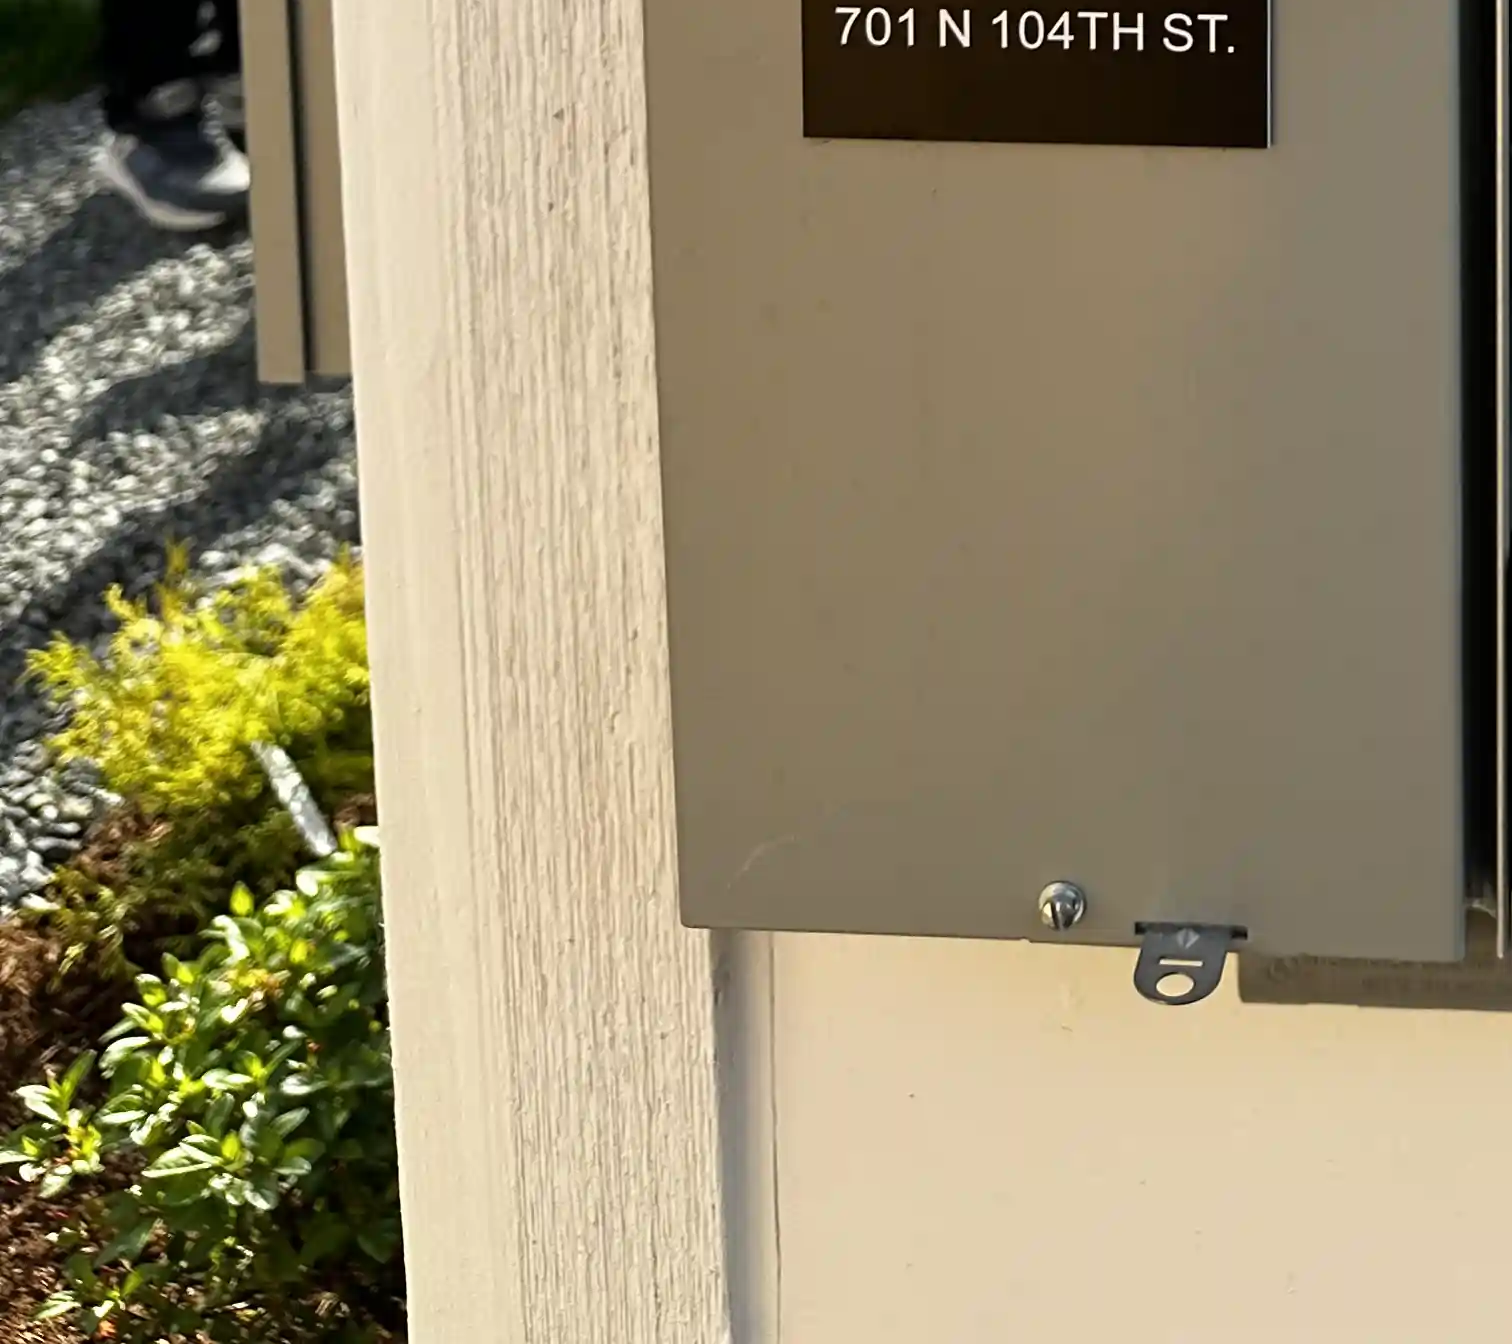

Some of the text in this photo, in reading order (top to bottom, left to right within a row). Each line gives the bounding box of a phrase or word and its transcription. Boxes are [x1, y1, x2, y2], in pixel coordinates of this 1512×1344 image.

[834, 6, 1235, 54] 701 N 104TH ST.
